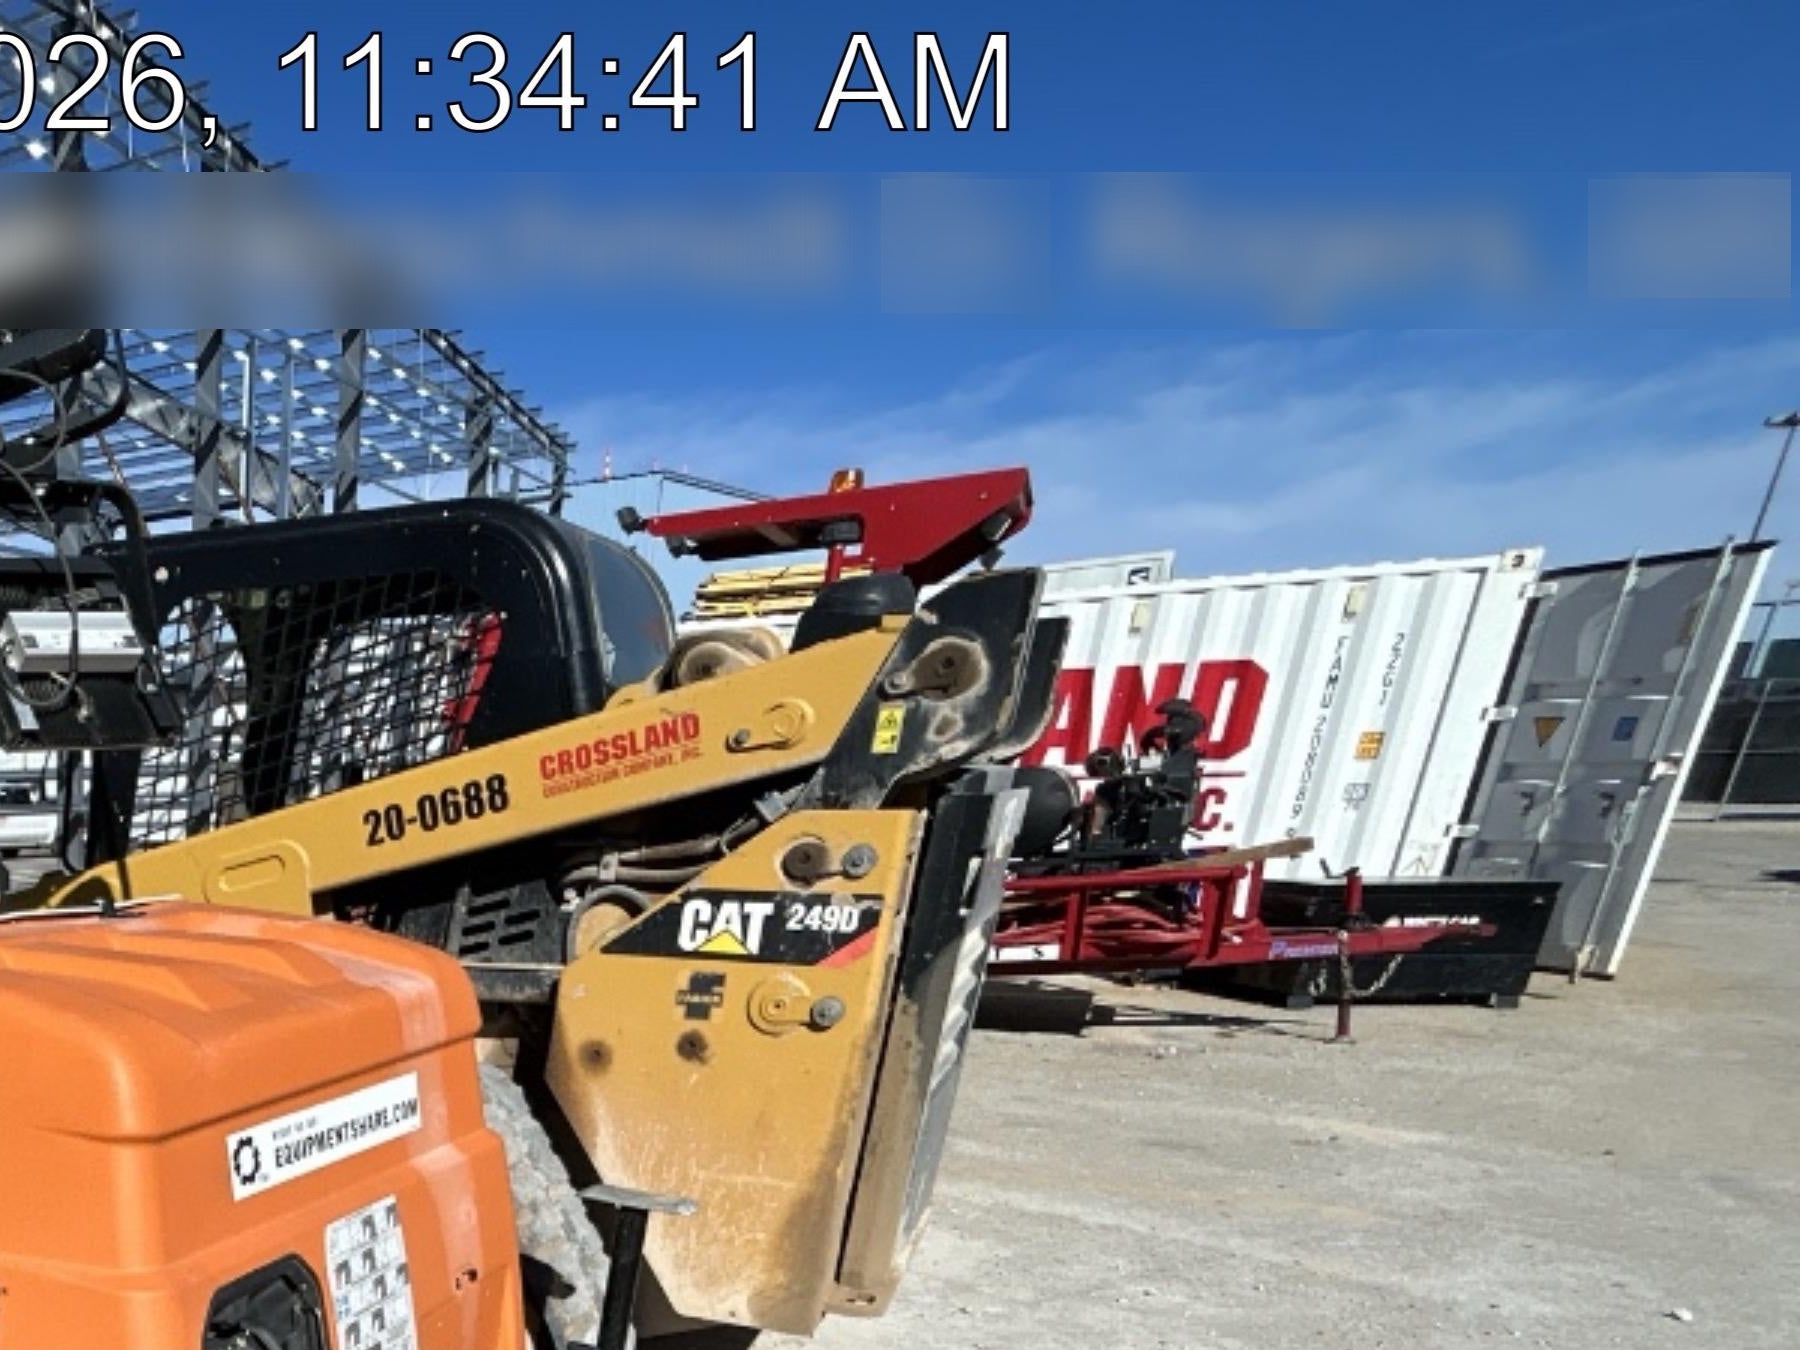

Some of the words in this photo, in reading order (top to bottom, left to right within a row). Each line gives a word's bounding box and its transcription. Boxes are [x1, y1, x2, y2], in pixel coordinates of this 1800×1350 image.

[539, 712, 701, 781] CROSSLAND
[363, 774, 510, 847] 20-0688
[677, 898, 774, 955] CAT
[785, 902, 860, 933] 249D
[274, 1098, 419, 1168] EQUIPMENTSHARE.COM
